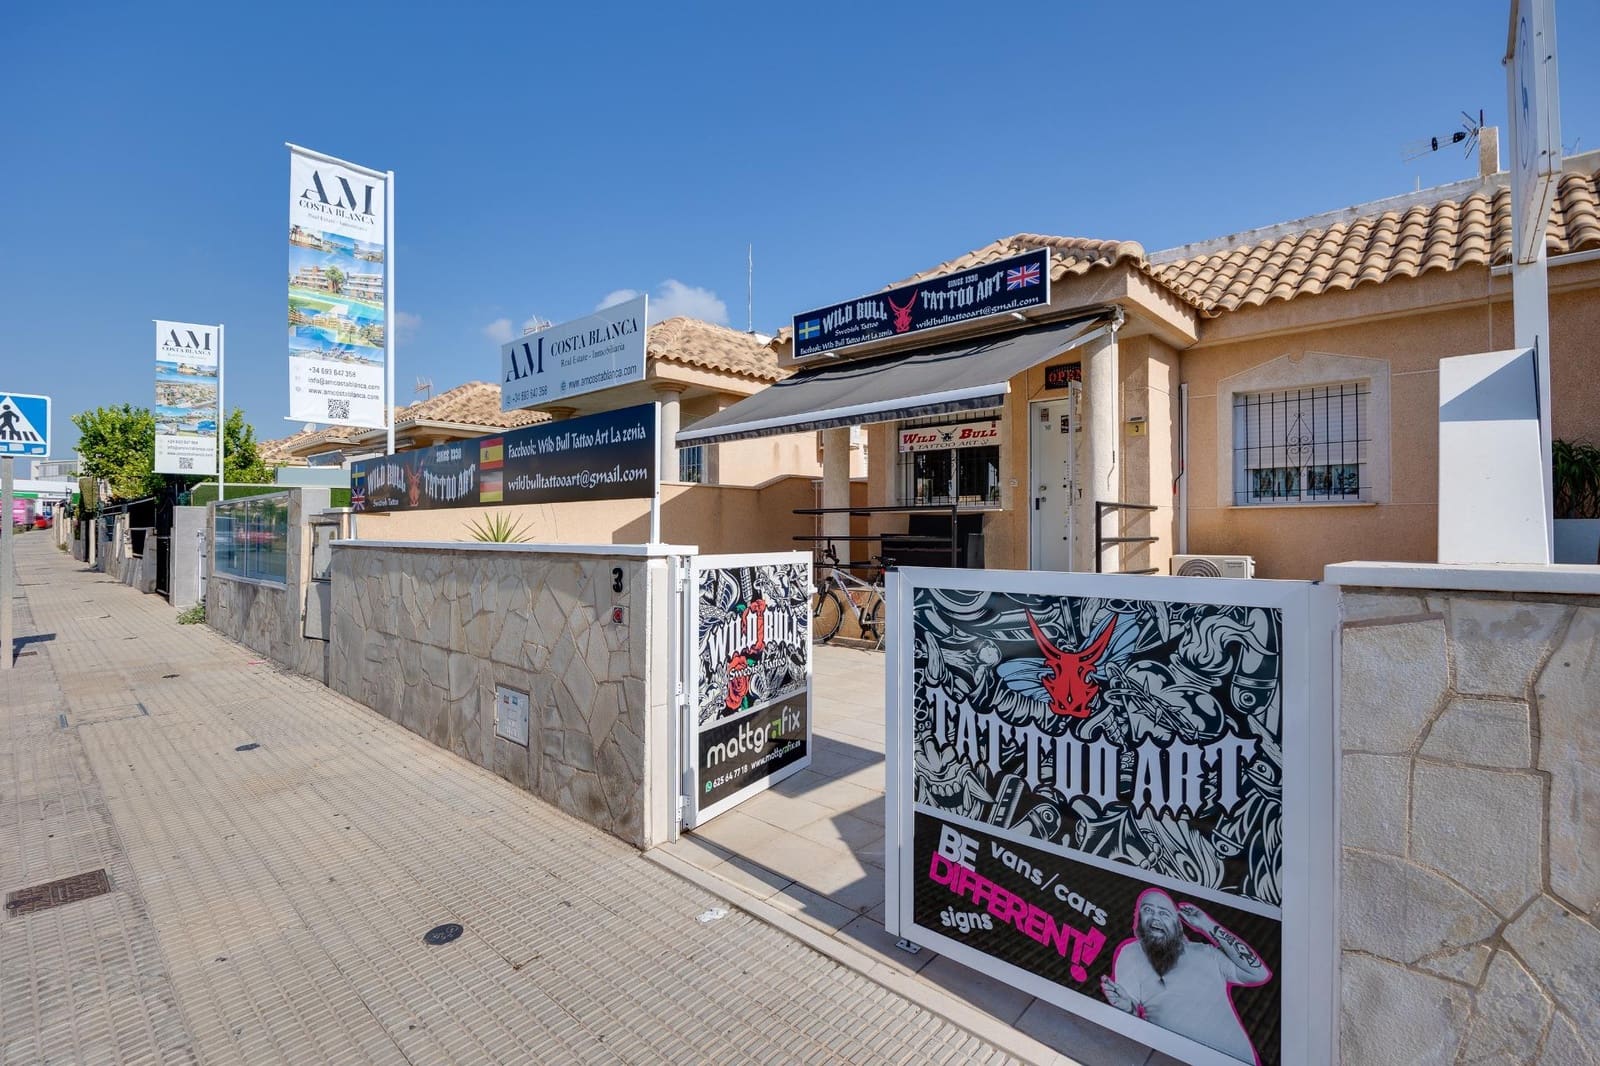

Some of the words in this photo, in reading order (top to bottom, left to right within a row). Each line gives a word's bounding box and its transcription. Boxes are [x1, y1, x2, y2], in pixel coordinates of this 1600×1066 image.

[300, 170, 375, 216] AM
[299, 199, 333, 216] COSTA
[336, 209, 374, 225] BLANCA
[921, 287, 974, 311] TATTOO
[976, 271, 1005, 303] ART
[822, 305, 852, 335] WILD
[856, 300, 888, 321] BULL
[915, 296, 1039, 329] wildbulltattooart@gmail.com
[163, 329, 211, 350] AM
[550, 334, 586, 357] COSTA
[589, 317, 638, 345] BLANCA
[861, 333, 871, 342] Art
[505, 337, 545, 383] AM
[508, 442, 537, 459] Facebook:
[556, 434, 570, 452] Bull
[570, 432, 594, 449] Tattoo
[594, 430, 609, 446] Art
[610, 428, 621, 443] La
[622, 421, 646, 441] zenia
[367, 464, 385, 496] WILD
[387, 463, 406, 493] BULL
[424, 469, 457, 502] TATTOO
[458, 463, 476, 500] ART
[508, 465, 648, 491] wildbulltattooart@gmail.com
[612, 567, 623, 592] 3
[708, 610, 758, 673] WILD
[763, 608, 800, 650] BULL
[923, 685, 1122, 803] TATTOO
[1131, 730, 1259, 818] ART
[713, 775, 724, 788] 625
[937, 824, 981, 873] BE
[928, 850, 1107, 982] DIFFERENT!
[940, 906, 993, 934] signs
